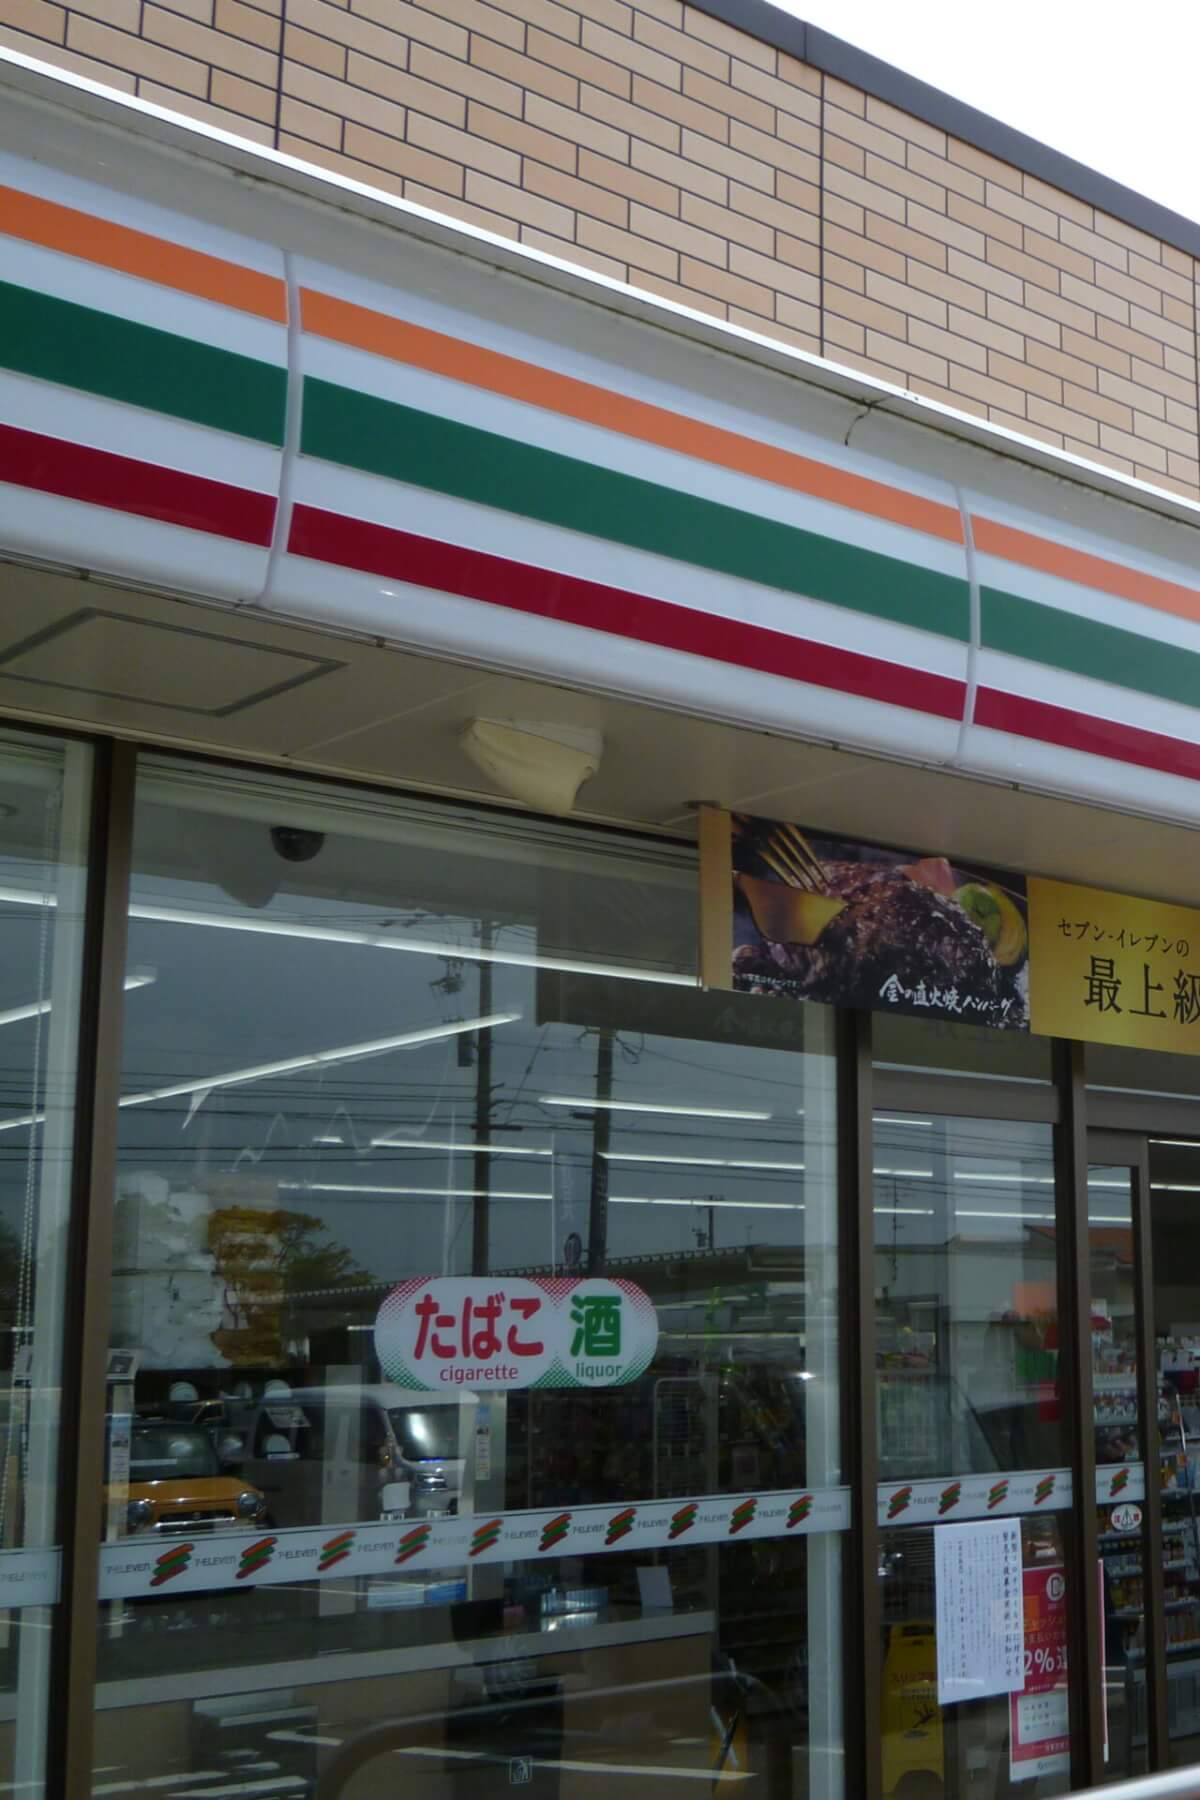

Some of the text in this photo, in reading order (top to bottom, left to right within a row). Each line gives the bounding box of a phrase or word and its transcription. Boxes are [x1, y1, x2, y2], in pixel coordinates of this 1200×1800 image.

[414, 1292, 544, 1360] たばこ
[570, 1294, 622, 1357] 酒
[439, 1364, 519, 1384] cigarette
[575, 1363, 623, 1381] liquor
